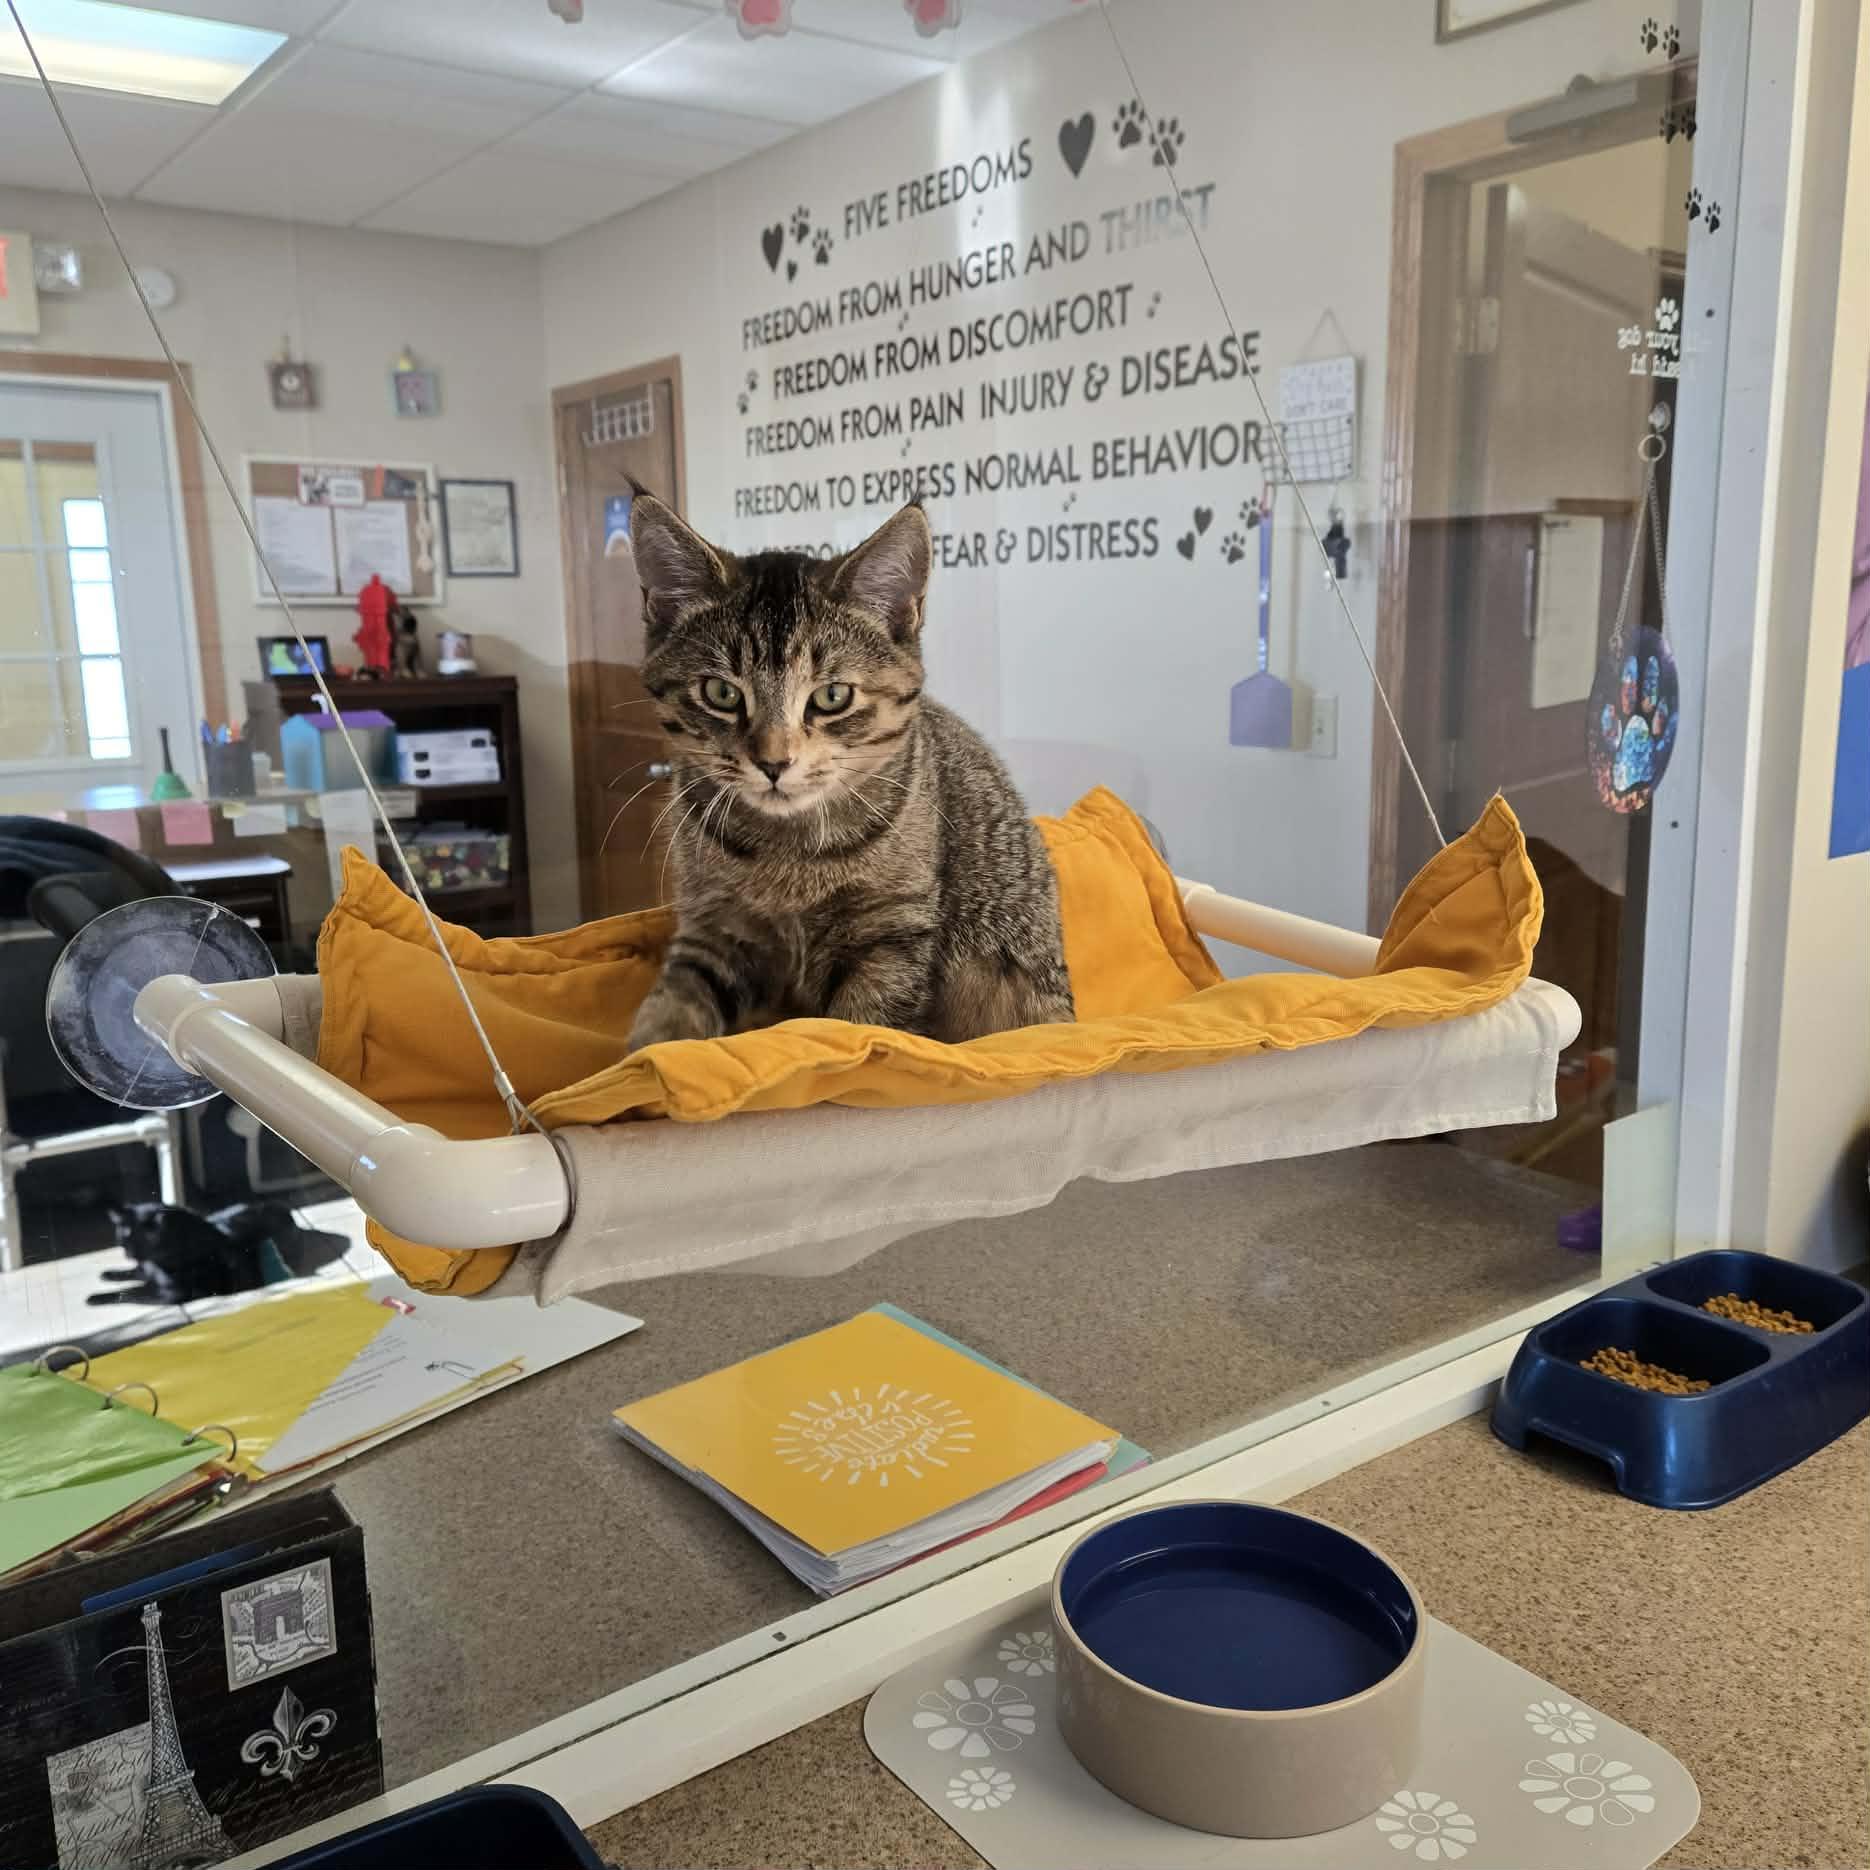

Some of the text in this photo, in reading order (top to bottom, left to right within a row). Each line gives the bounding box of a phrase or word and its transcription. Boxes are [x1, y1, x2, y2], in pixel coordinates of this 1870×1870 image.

[844, 139, 1033, 239] FIVE FREEDOMS
[742, 183, 1217, 351] FREEDOM FROM HUNGER AND THIRST
[773, 284, 1133, 400] FREEDOM FROM DISCOMFORT
[745, 414, 835, 457] FREEDOM
[840, 402, 903, 443] FROM
[909, 387, 965, 432] PAIN
[980, 367, 1075, 421] INJURY
[1084, 361, 1110, 402] &
[1121, 331, 1262, 396] DISEASE
[735, 419, 1264, 519] FREEDOM TO EXPRESS NORMAL BEHAVIOR
[931, 516, 1160, 569] FEAR & DISTRESS
[810, 1410, 933, 1463] POSITIVE
